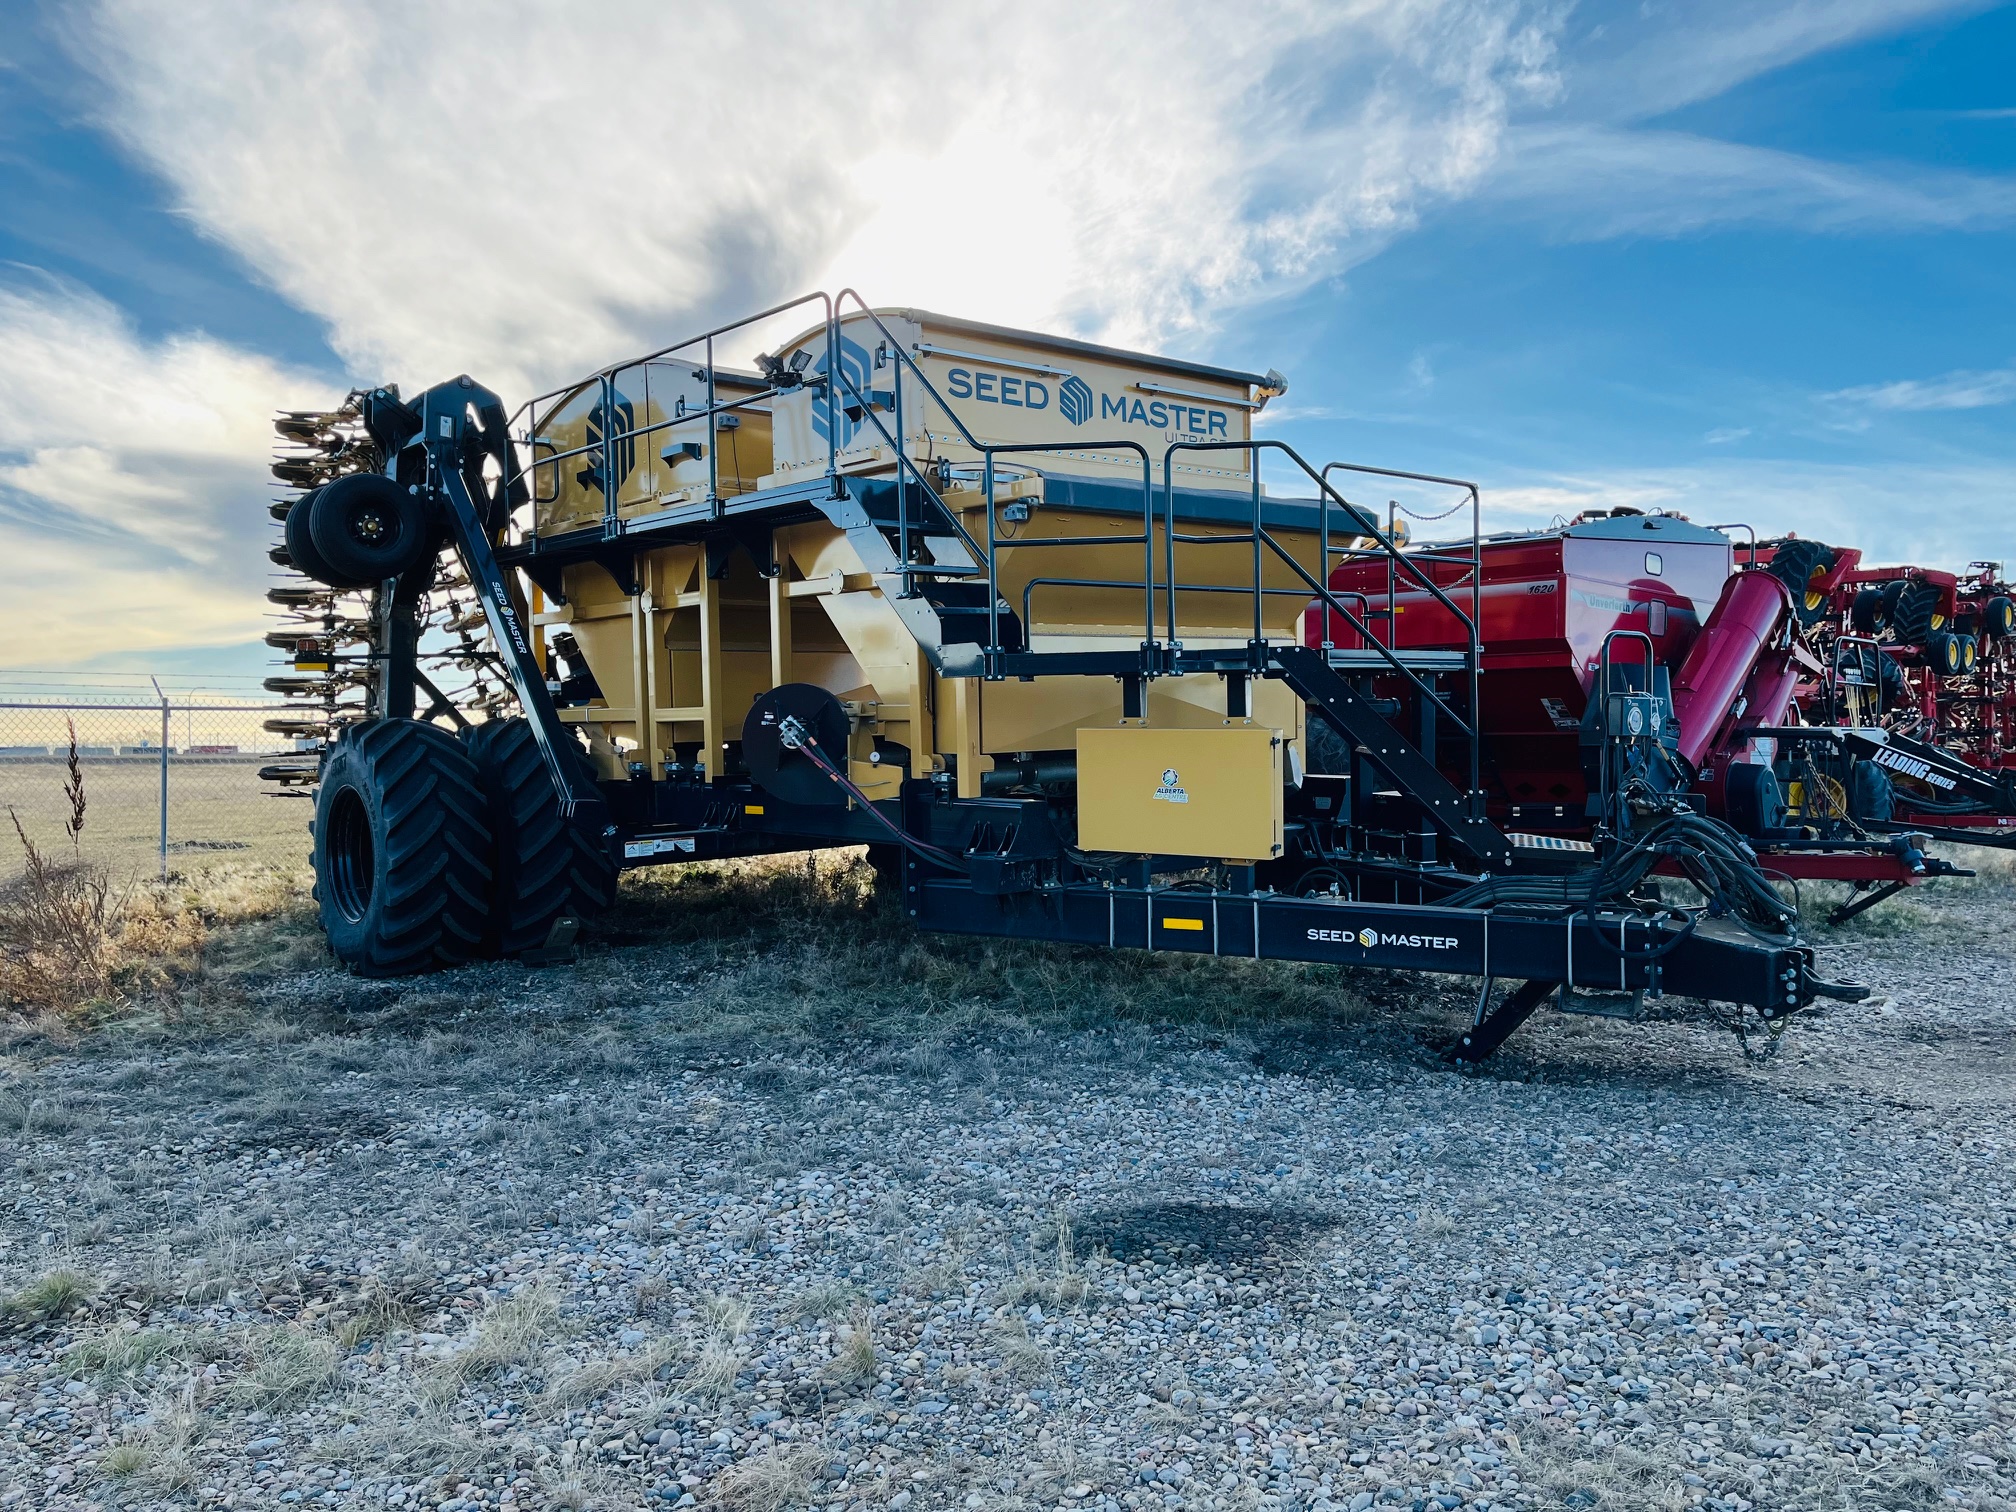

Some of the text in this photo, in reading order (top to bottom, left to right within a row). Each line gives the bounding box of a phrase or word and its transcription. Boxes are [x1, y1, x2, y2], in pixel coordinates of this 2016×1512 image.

[948, 368, 1228, 438] SEED MASTER
[1528, 584, 1555, 595] 1620
[1589, 594, 1631, 613] Unverferth
[492, 581, 527, 654] SEED MASTER
[1872, 747, 1957, 791] LEADING SERIES
[1307, 929, 1459, 949] SEED MASTER
